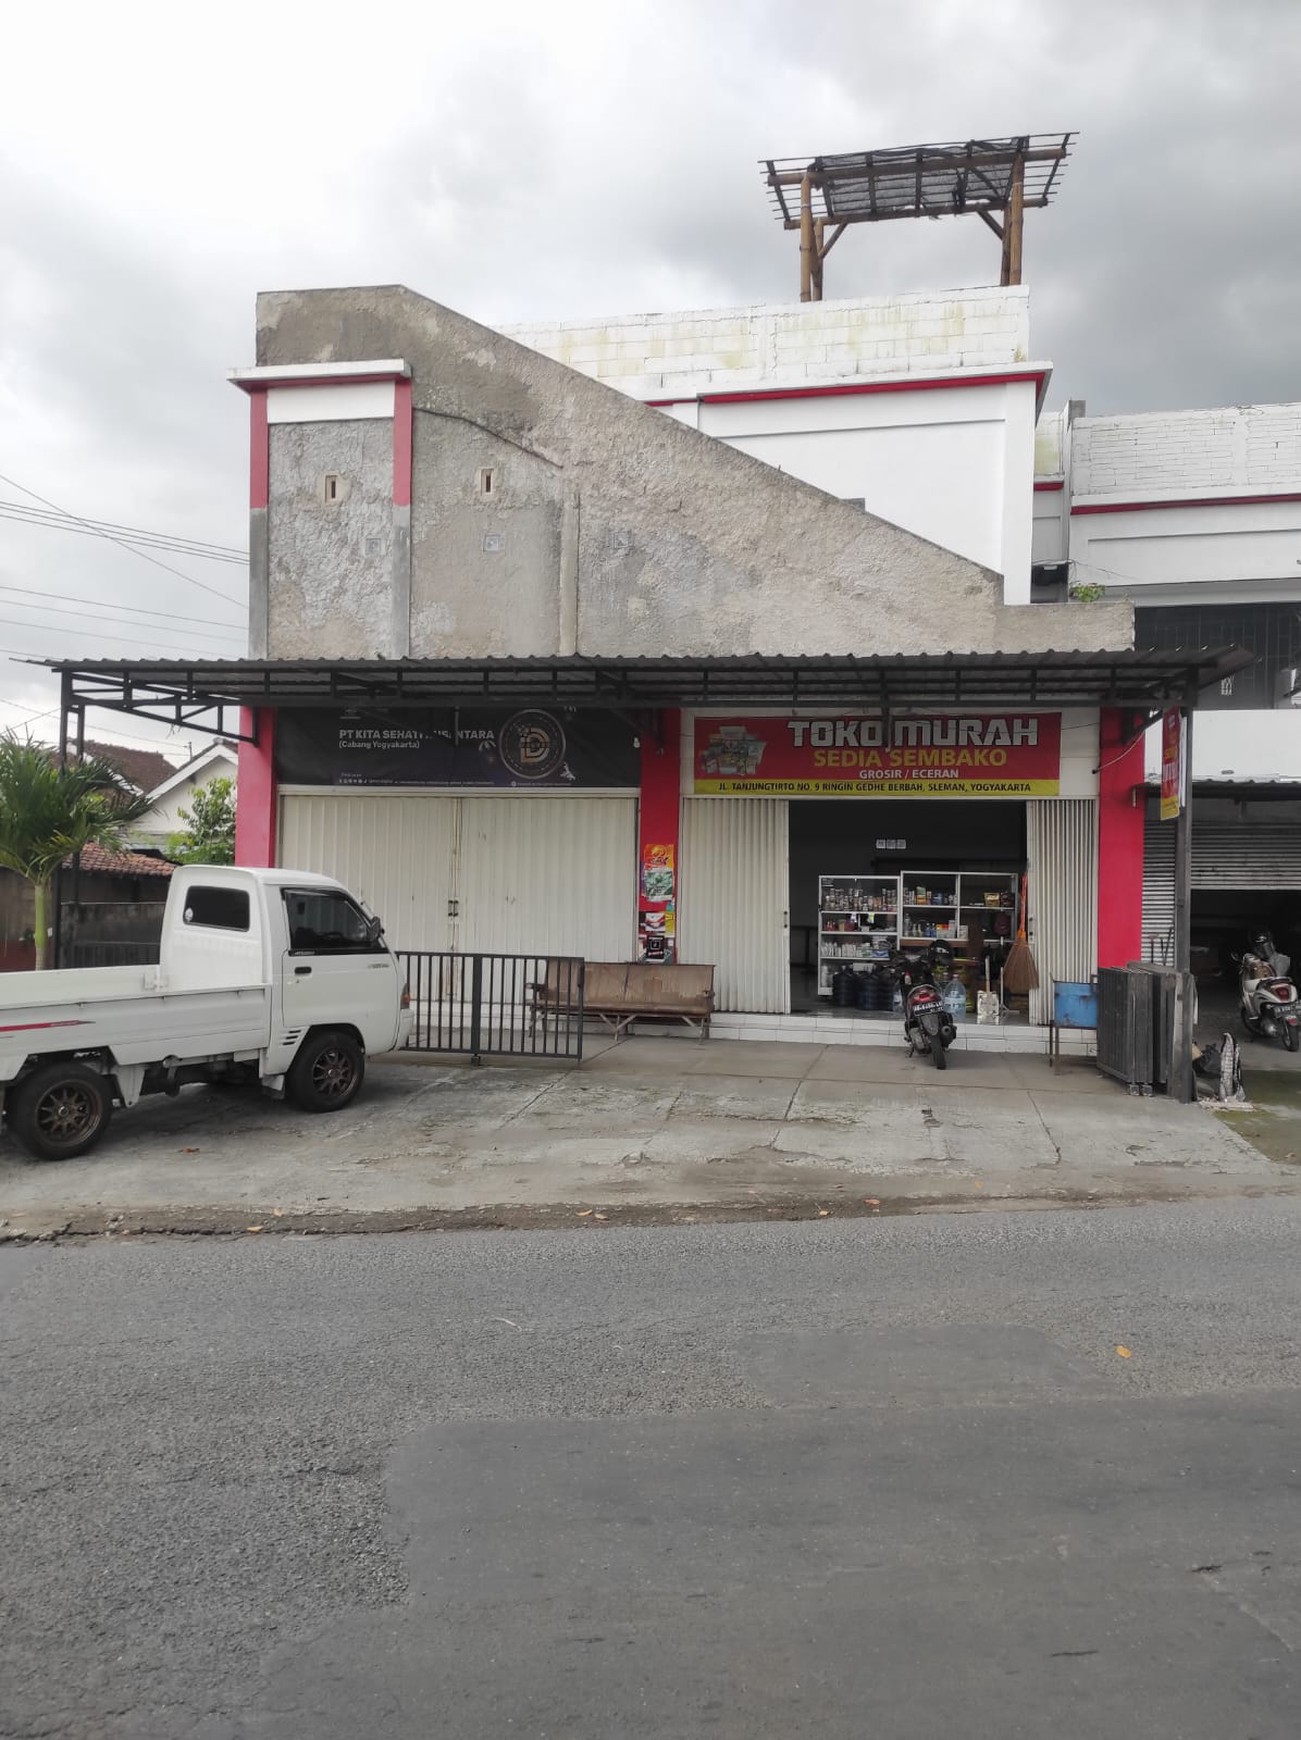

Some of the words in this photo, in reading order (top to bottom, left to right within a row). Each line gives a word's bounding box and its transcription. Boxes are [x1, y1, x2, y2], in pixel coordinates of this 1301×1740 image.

[339, 729, 353, 739] PT
[355, 729, 381, 739] KITA
[787, 719, 882, 747] TOKO
[894, 718, 1038, 746] MURAH
[338, 740, 372, 749] (Cabang
[372, 740, 420, 749] Yogyakarta)
[814, 750, 882, 767] SEDIA
[889, 749, 1007, 767] SEMBAKO
[859, 769, 902, 780] GROSIR
[912, 769, 959, 779] ECERAN
[732, 783, 794, 791] TANJUNGTIRTO
[815, 783, 820, 791] 9
[822, 783, 853, 791] RINGIN
[856, 783, 884, 791] GEDHE
[888, 783, 926, 792] BERBAH,
[928, 783, 968, 792] SLEMAN,
[970, 783, 1031, 792] YOGYAKARTA
